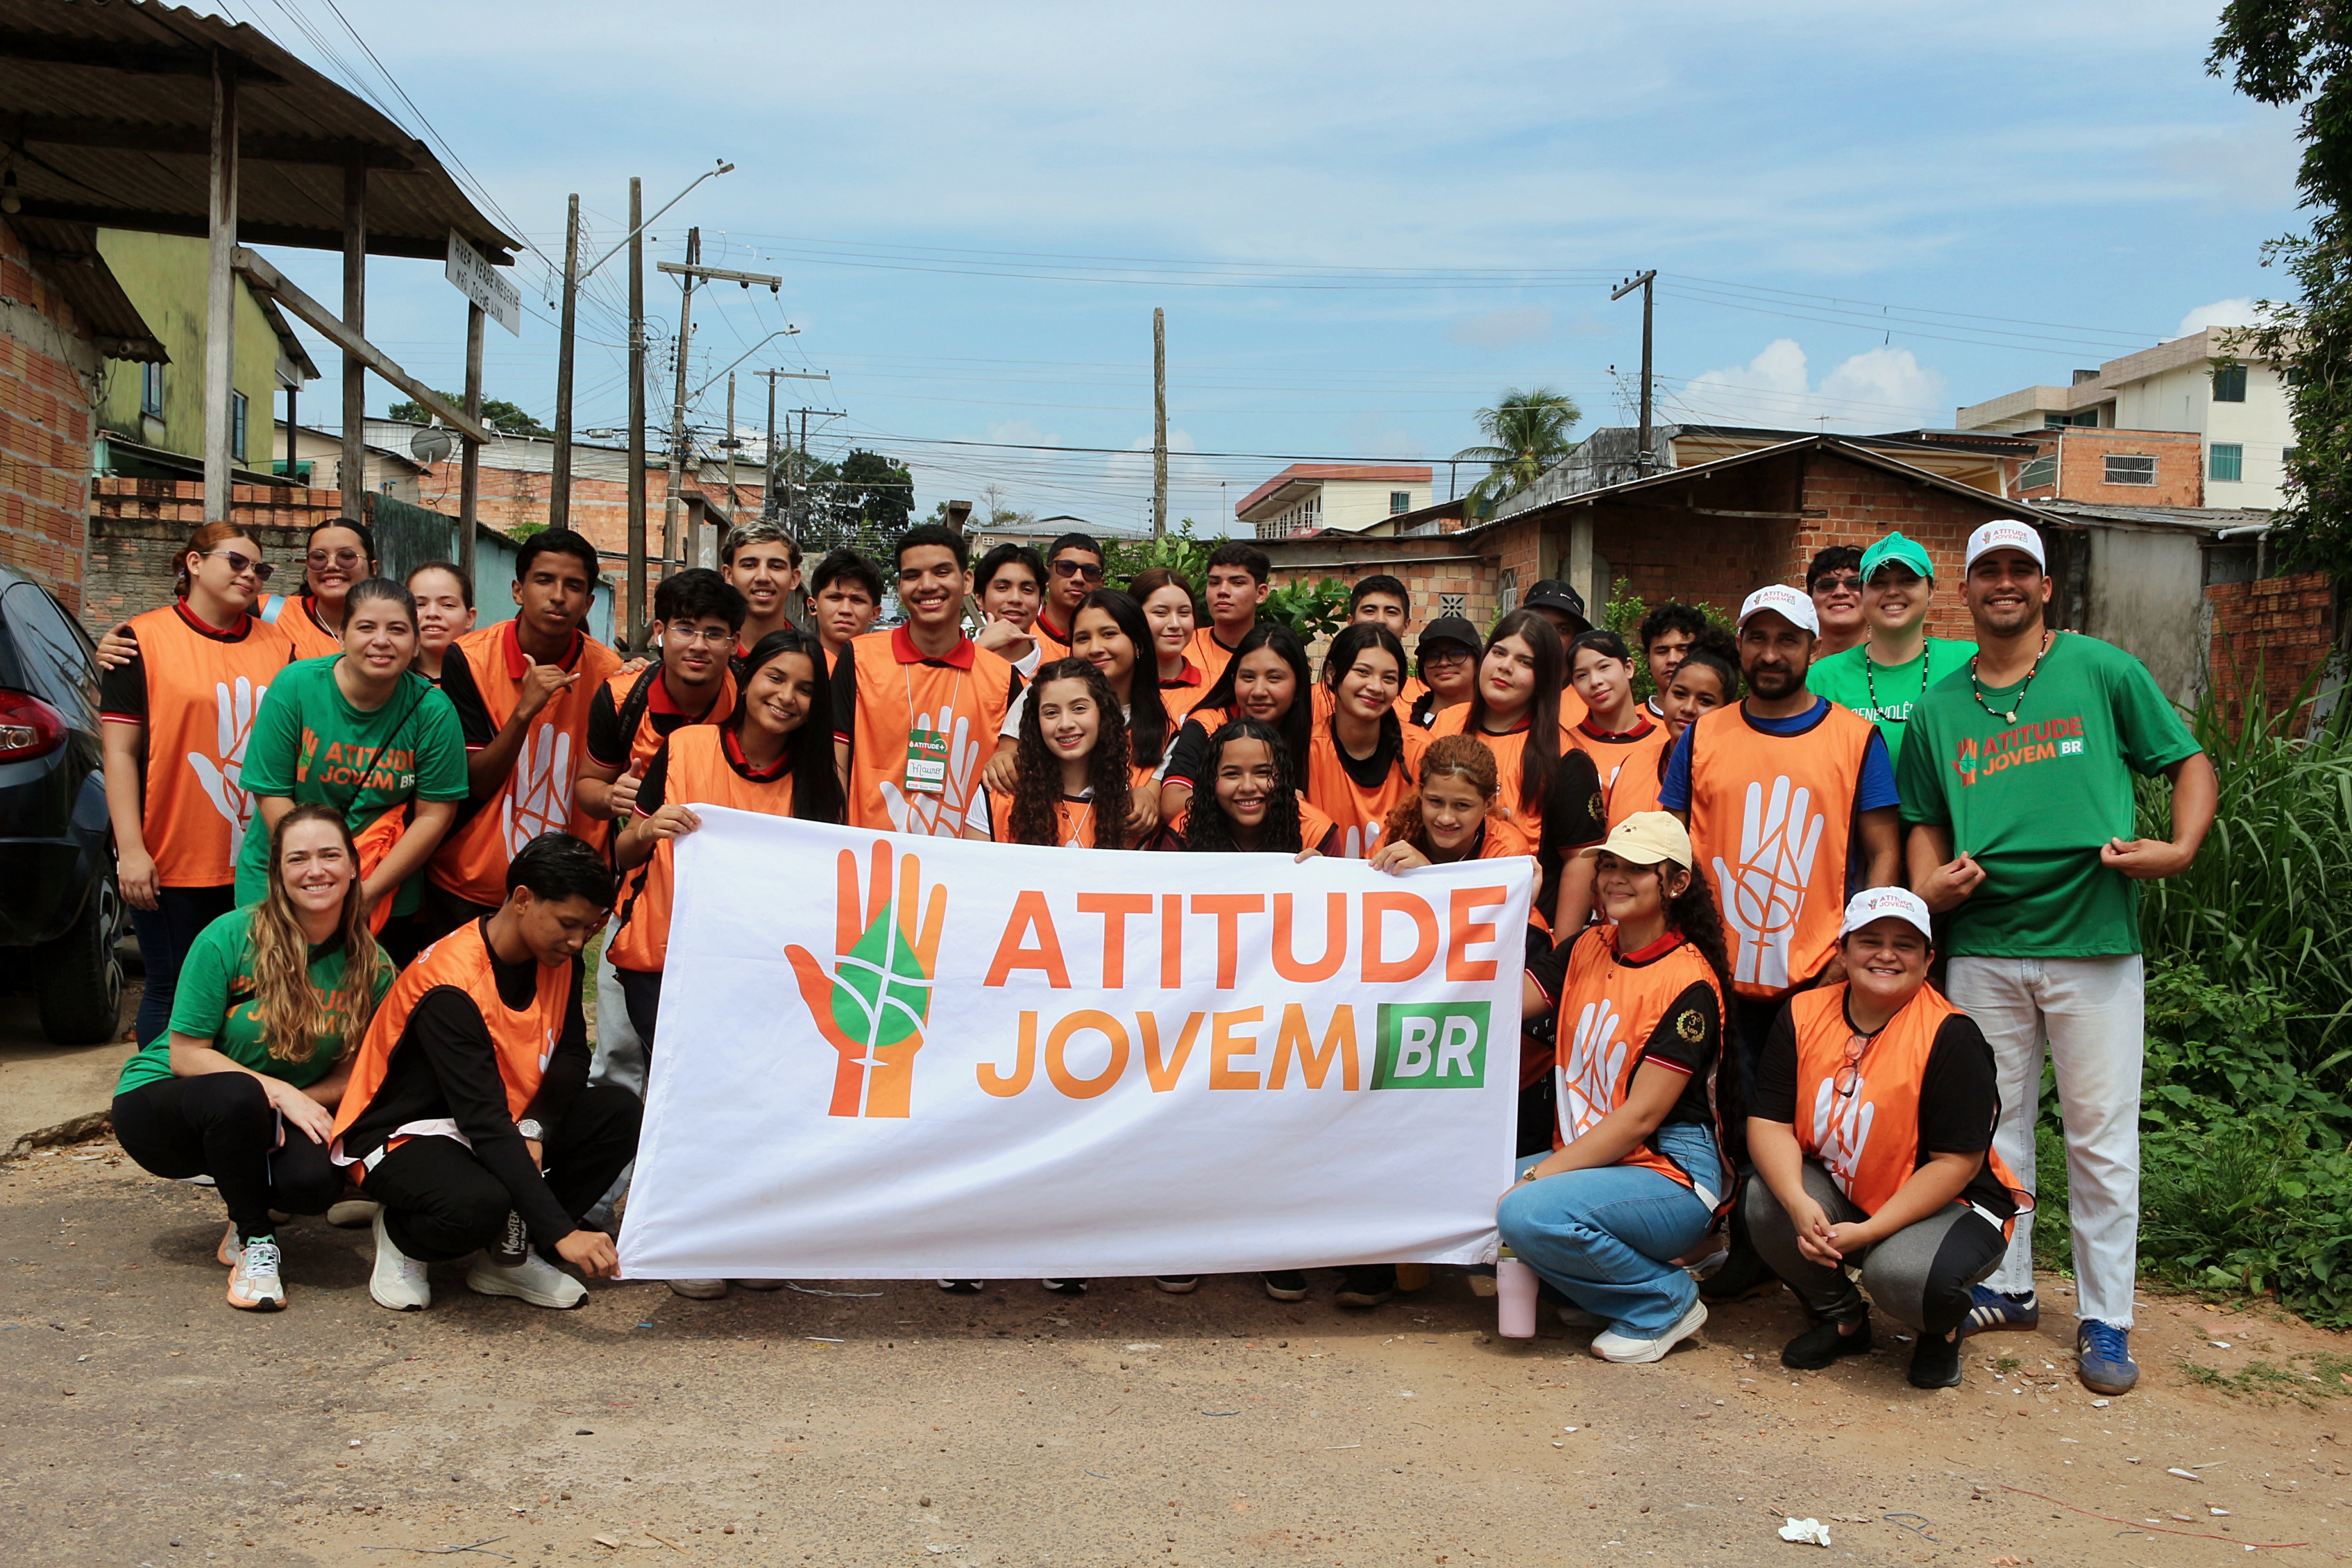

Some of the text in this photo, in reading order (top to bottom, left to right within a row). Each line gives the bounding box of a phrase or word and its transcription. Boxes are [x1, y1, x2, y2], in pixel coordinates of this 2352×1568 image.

[491, 301, 503, 322] LIXO
[1993, 529, 2028, 538] ATITUDE
[1763, 591, 1796, 600] ATITUDE
[1851, 700, 1913, 721] ENEVOLÊ
[1982, 716, 2084, 756] ATITUDE
[1982, 740, 2082, 776] JOVEM BR
[319, 765, 394, 791] JOVEM
[911, 762, 942, 776] Mauro
[1880, 895, 1914, 907] ATITUDE
[982, 885, 1508, 990] ATITUDE
[1684, 1025, 1698, 1035] Ano
[976, 1003, 1479, 1100] JOVEM BR
